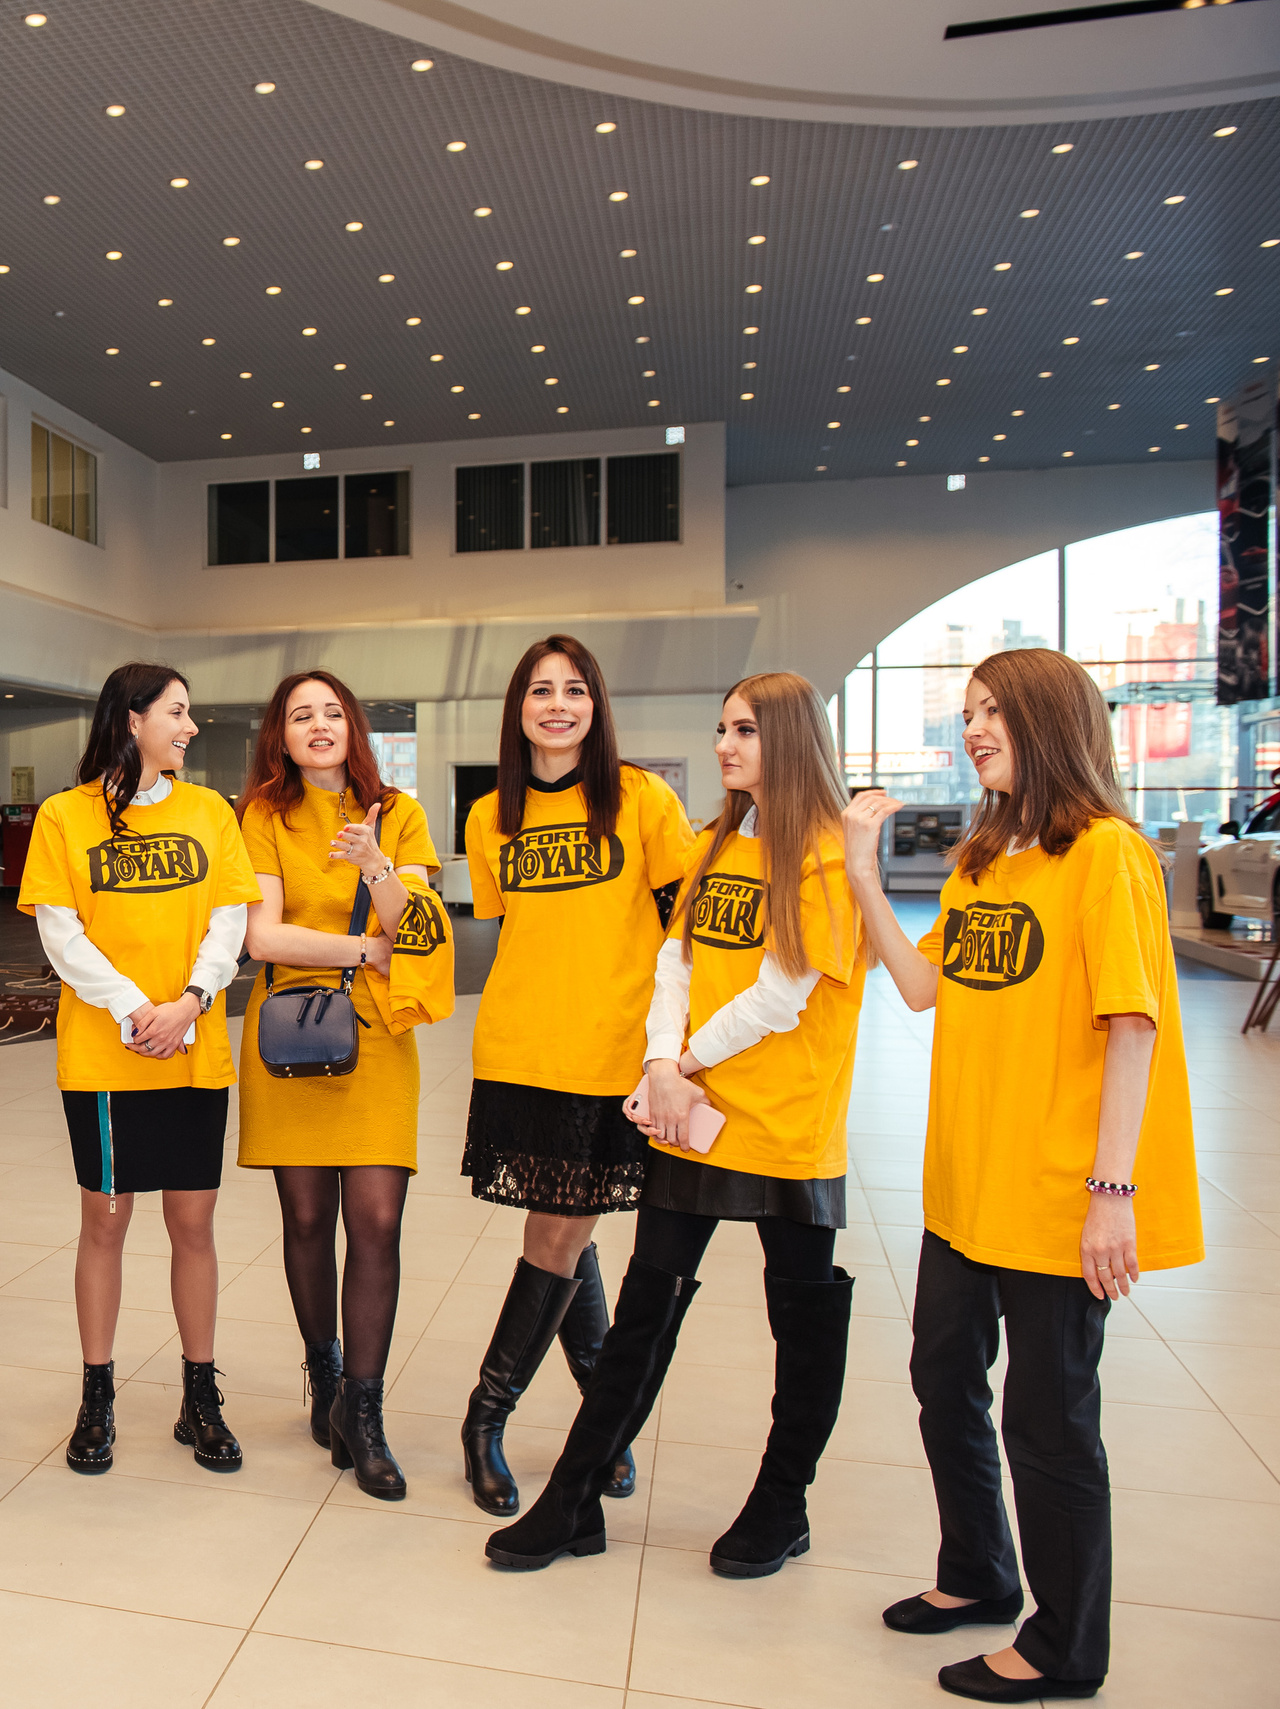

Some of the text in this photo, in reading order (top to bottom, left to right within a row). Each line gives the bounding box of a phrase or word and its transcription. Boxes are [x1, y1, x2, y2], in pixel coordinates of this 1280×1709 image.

[117, 839, 172, 854] FORT
[525, 830, 585, 848] FORT
[86, 838, 209, 894] BOYARD
[499, 831, 625, 894] BOYARD
[707, 881, 755, 898] FORT
[968, 911, 1011, 929] FORT
[942, 907, 1045, 983] BOYARD
